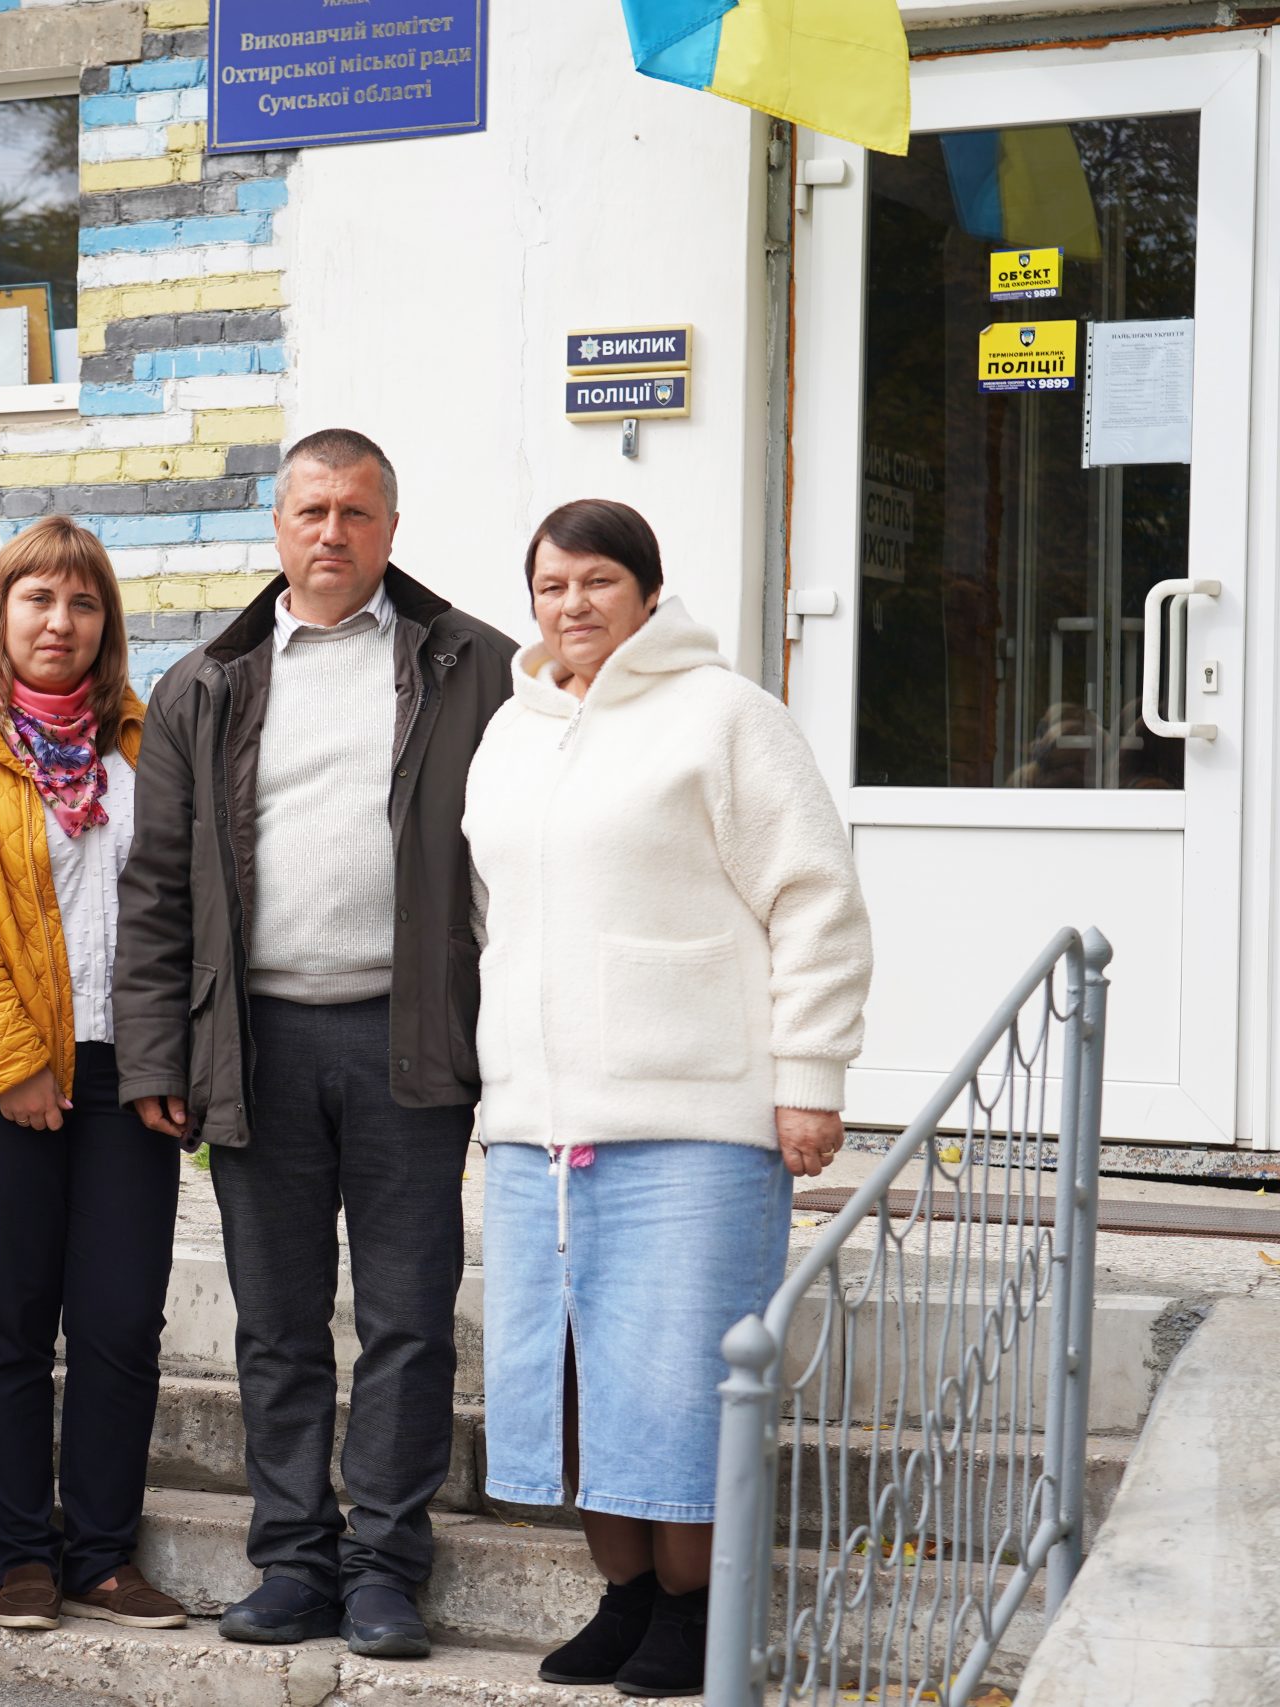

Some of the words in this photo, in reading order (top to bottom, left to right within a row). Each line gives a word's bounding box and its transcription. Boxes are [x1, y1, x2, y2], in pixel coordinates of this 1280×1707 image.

[240, 20, 367, 51] Виконавчий
[372, 15, 454, 38] комітет
[221, 57, 336, 86] Охтирської
[340, 49, 416, 74] міської
[420, 46, 472, 71] ради
[258, 87, 350, 116] Сумської
[354, 79, 433, 105] області
[1033, 288, 1057, 298] 9899
[602, 336, 676, 356] ВИКЛИК
[988, 350, 1034, 358] ТЕРМІНОВИЙ
[987, 356, 1066, 375] ПОЛІЦІЇ
[577, 382, 652, 405] ПОЛІЦІЇ
[1038, 378, 1070, 389] 9899
[866, 488, 911, 531] СТОЇТЬ
